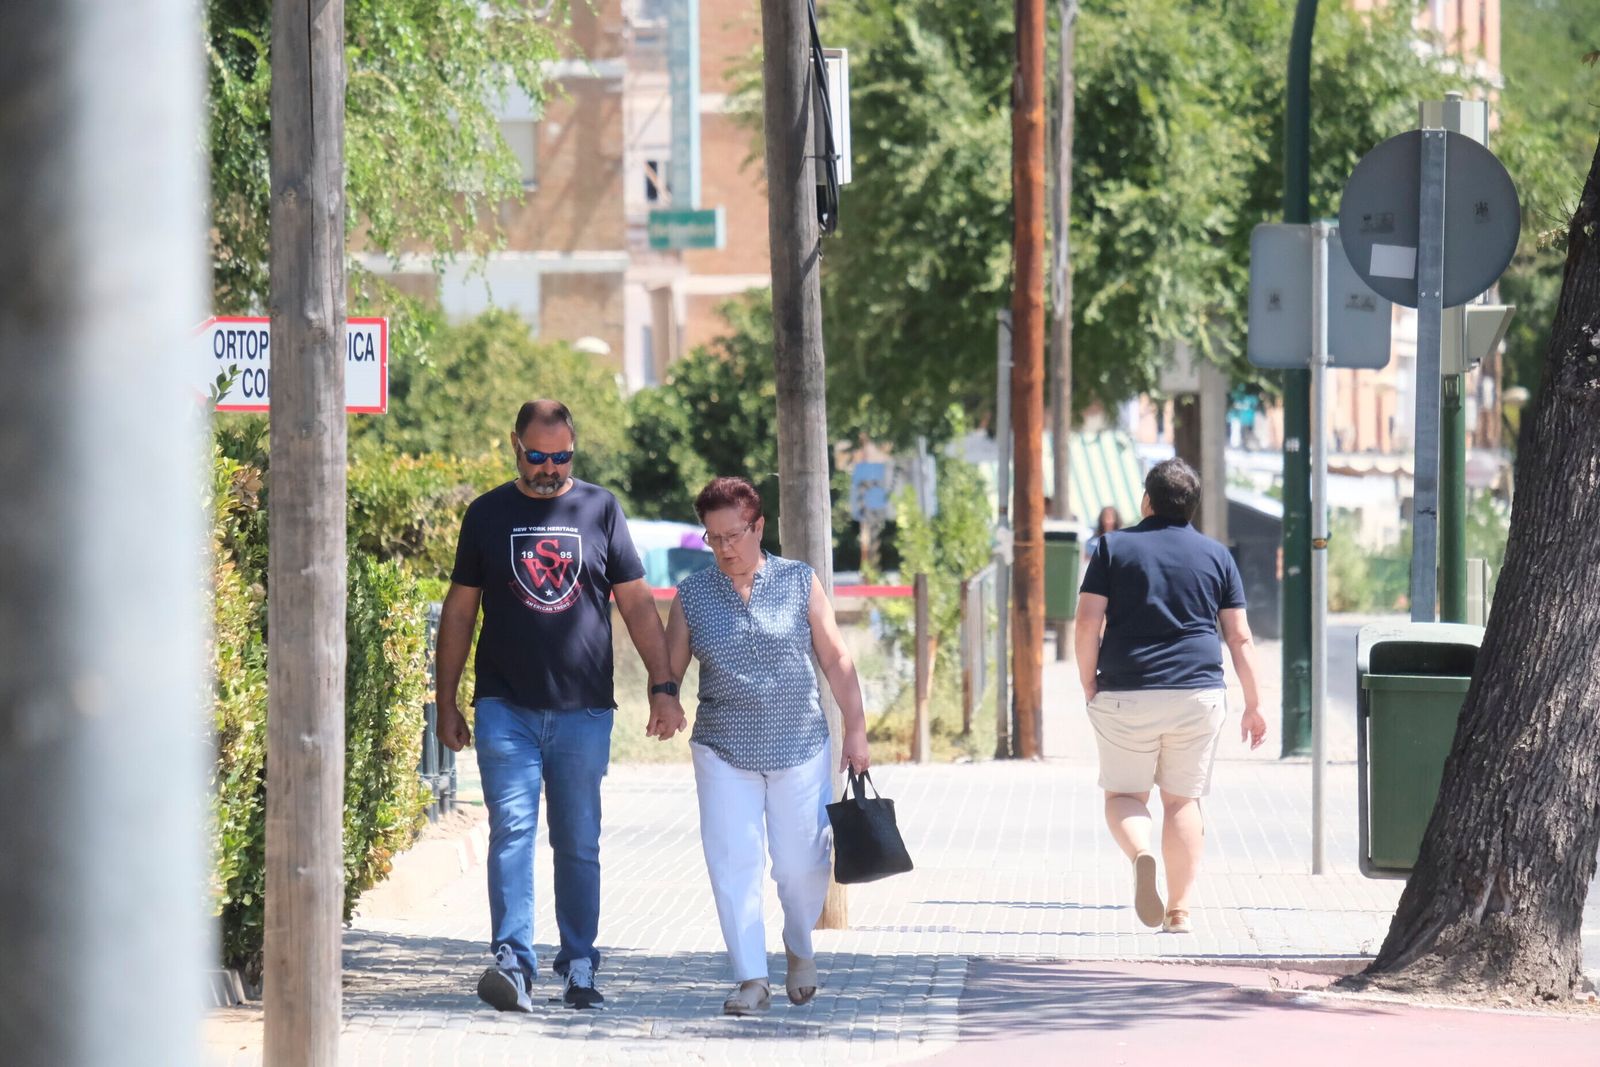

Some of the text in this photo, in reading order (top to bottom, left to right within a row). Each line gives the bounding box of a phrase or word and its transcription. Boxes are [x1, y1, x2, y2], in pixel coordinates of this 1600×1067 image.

[345, 331, 375, 362] ICA
[521, 551, 572, 559] 19 95
[526, 600, 553, 611] AMERICAN
